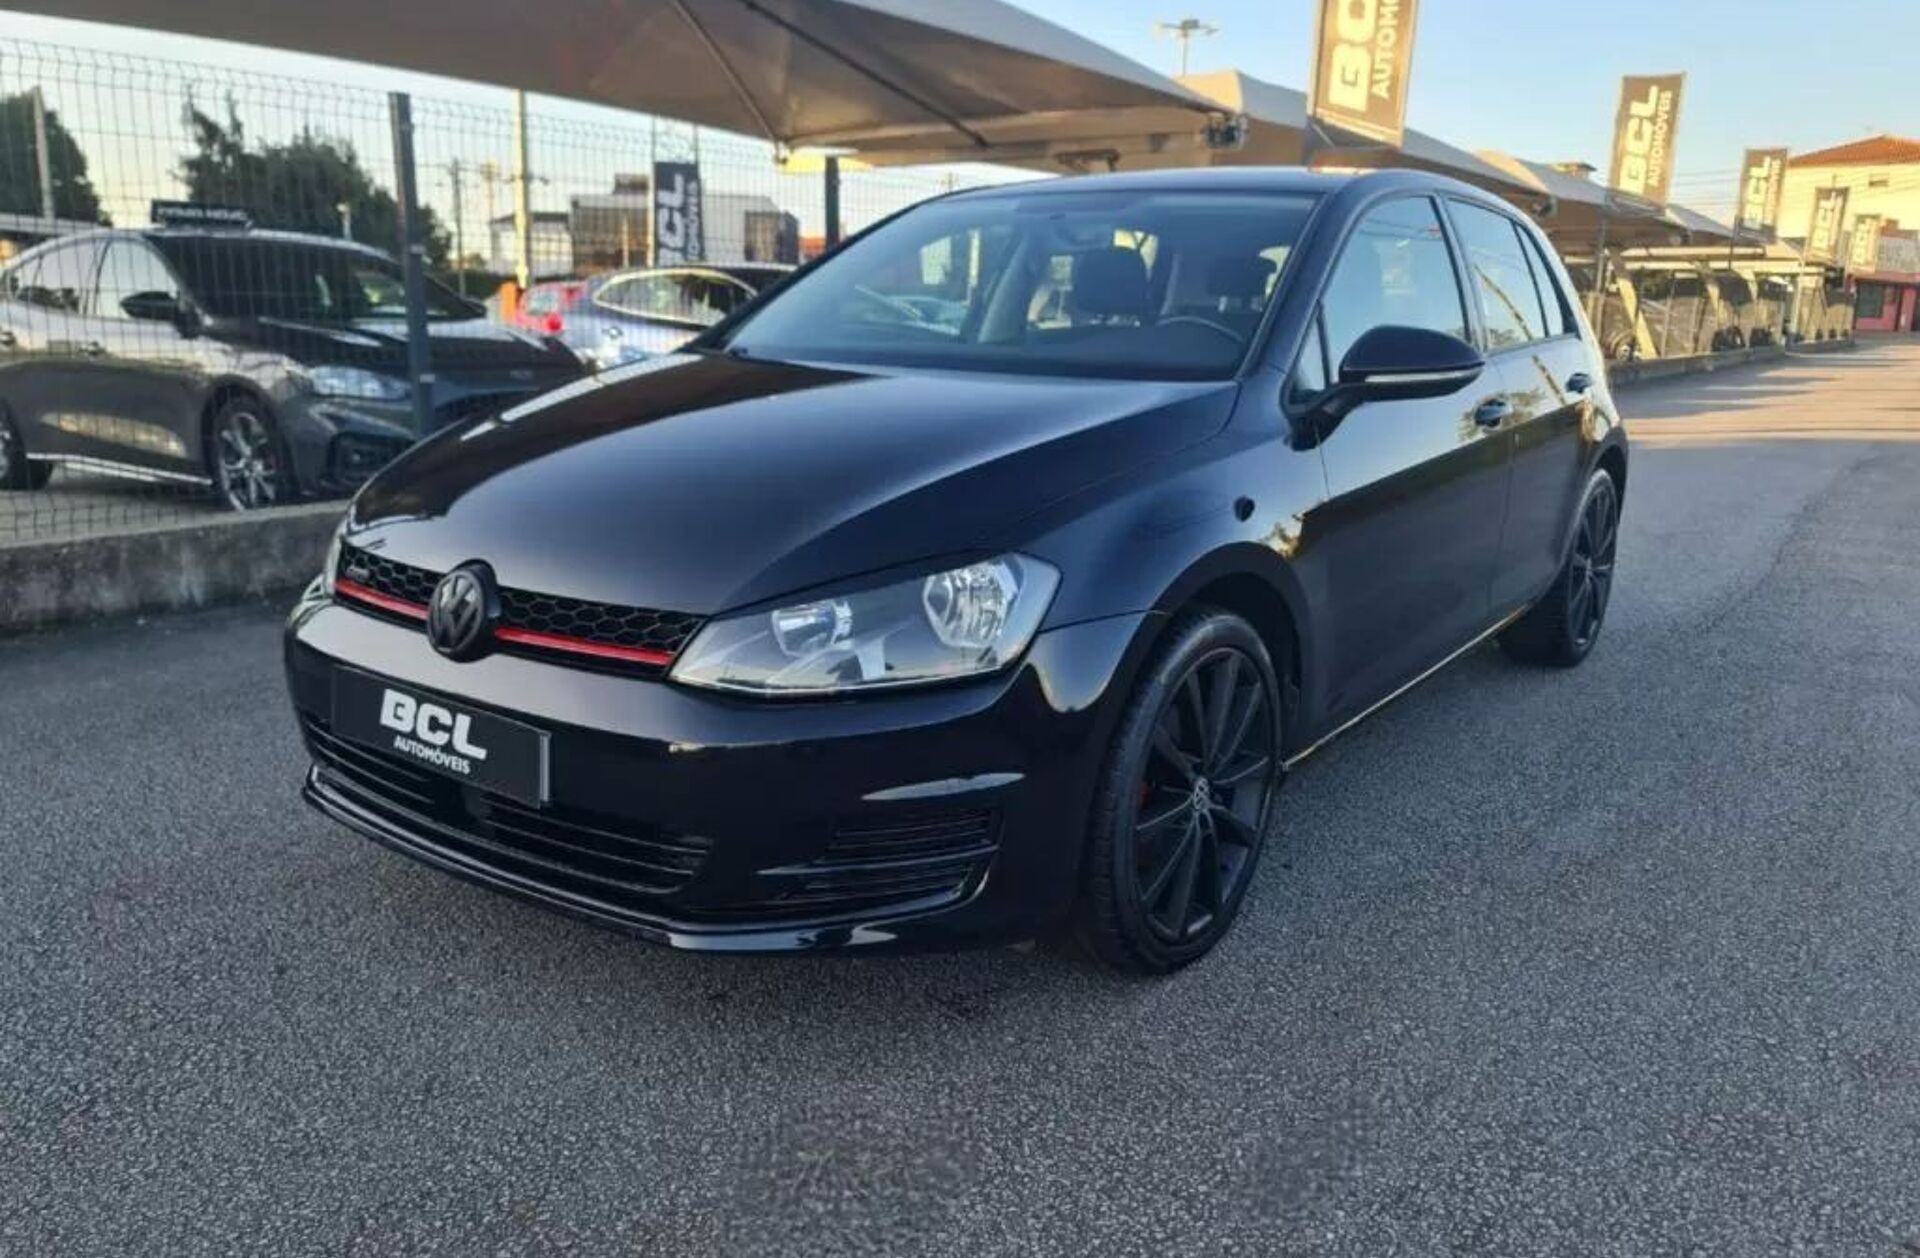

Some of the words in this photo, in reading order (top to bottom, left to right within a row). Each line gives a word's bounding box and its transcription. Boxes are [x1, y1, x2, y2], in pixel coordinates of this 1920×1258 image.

[1371, 0, 1401, 100] AUTOM
[1619, 85, 1659, 195] BCL
[380, 688, 487, 761] BCL
[393, 735, 471, 775] AUTOMÓVEIS
